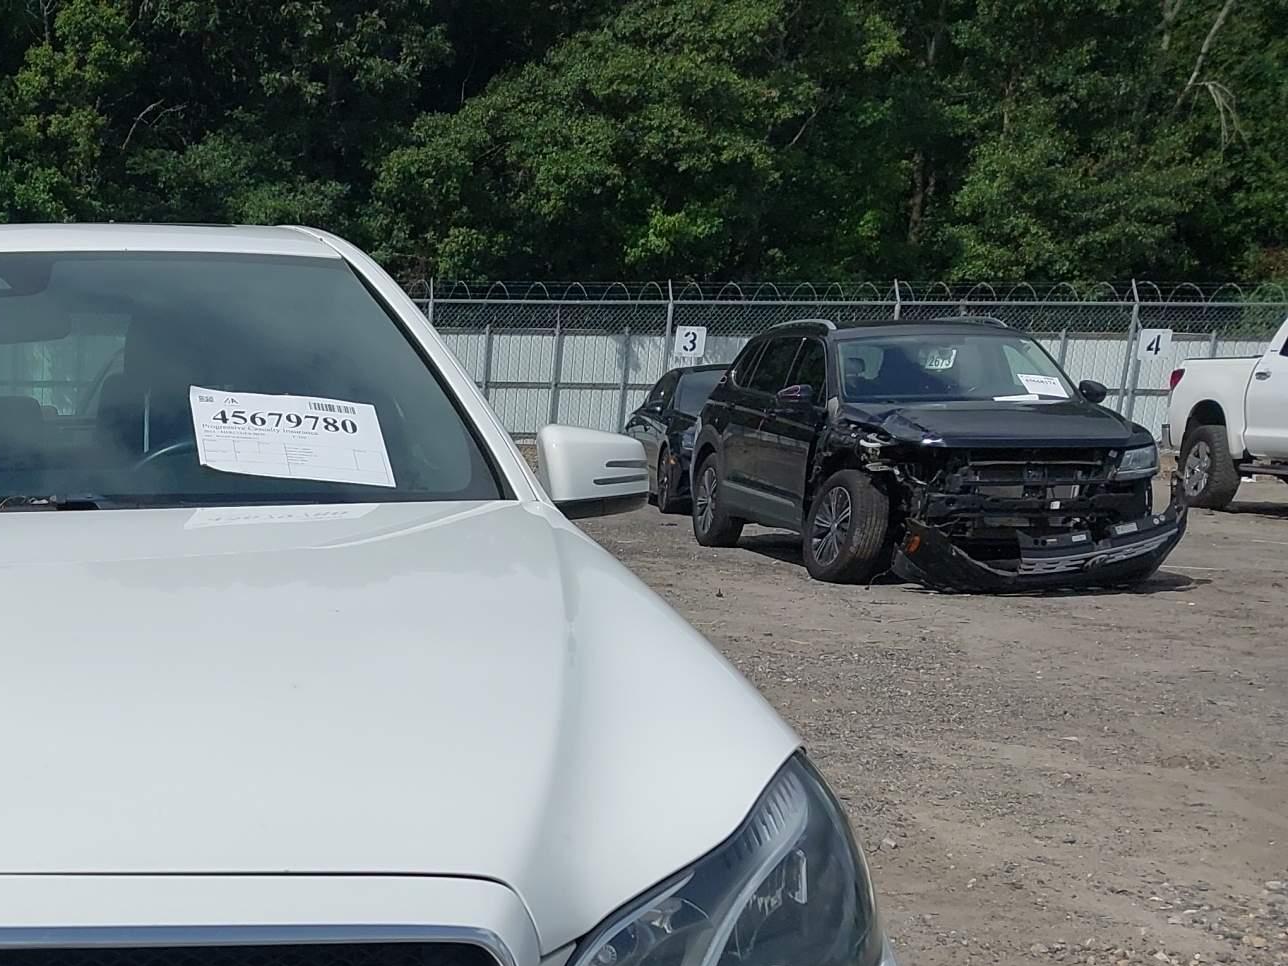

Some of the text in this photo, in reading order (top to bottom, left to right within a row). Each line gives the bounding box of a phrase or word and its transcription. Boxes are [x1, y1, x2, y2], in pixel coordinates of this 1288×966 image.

[682, 331, 697, 352] 3
[1146, 334, 1161, 355] 4
[212, 409, 358, 434] 45679780
